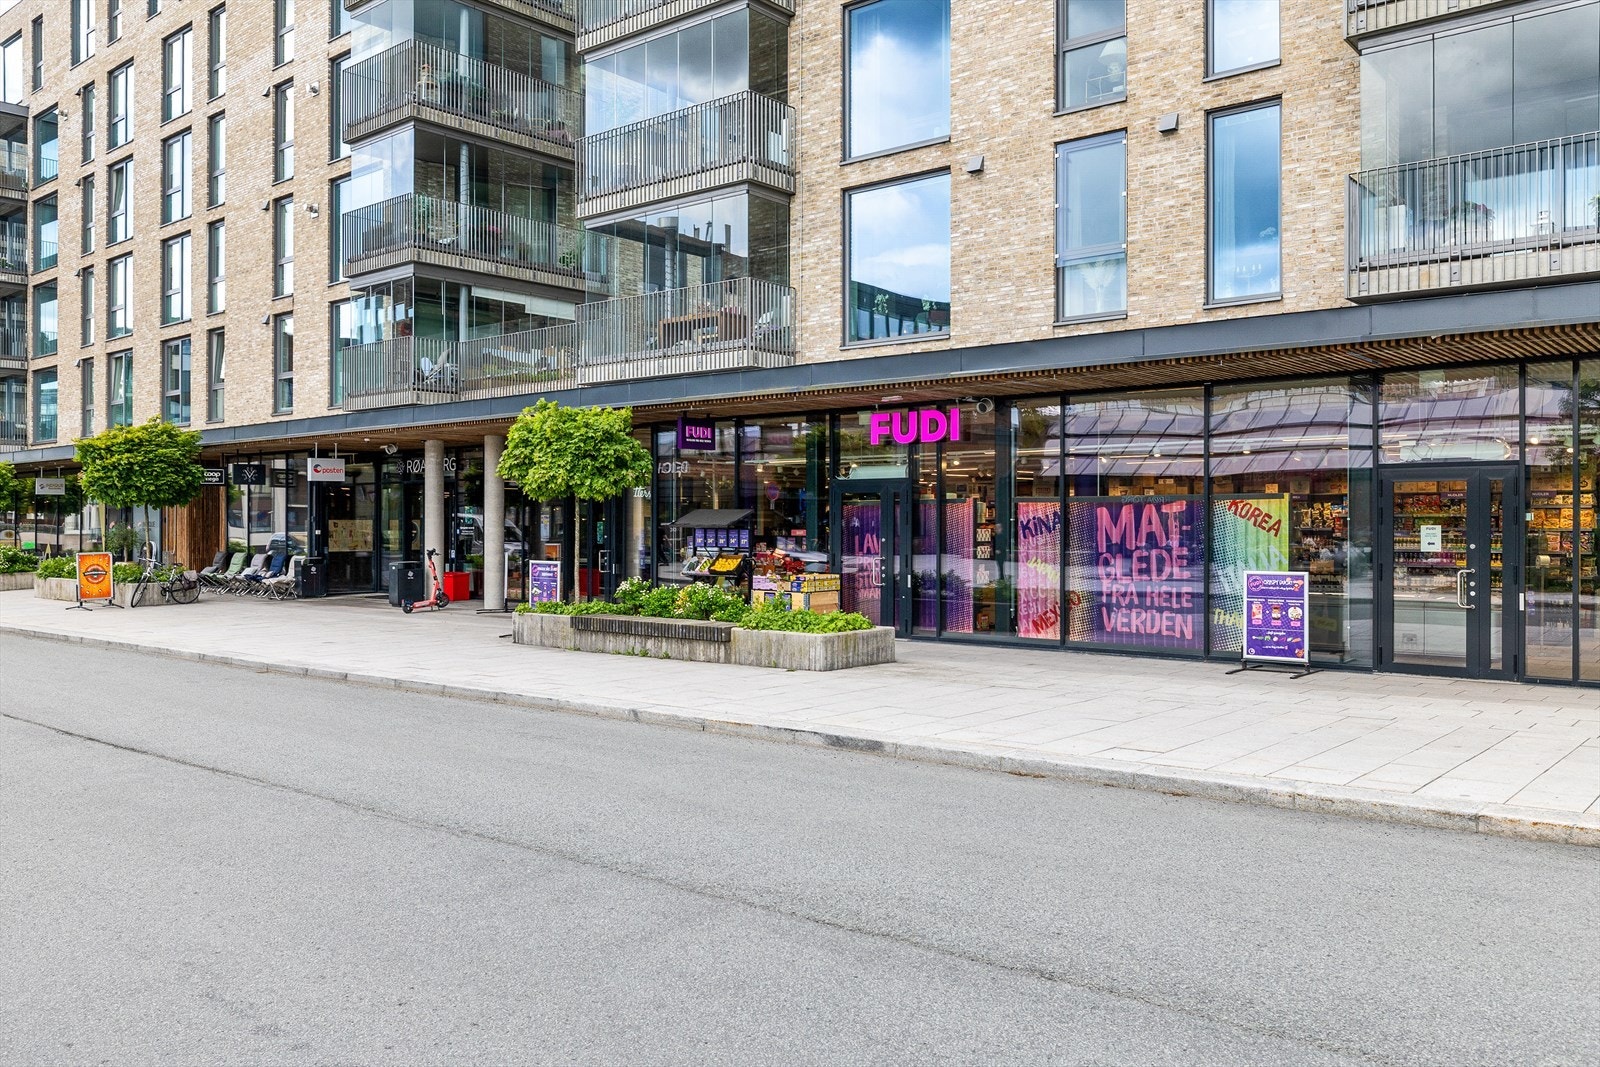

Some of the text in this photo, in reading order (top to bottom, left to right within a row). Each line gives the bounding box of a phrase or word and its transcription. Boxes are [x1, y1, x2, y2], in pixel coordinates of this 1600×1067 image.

[685, 425, 712, 439] FUDI
[870, 408, 960, 445] FUDI
[1227, 499, 1282, 538] KOREA
[1098, 546, 1192, 583] GLEDE
[1101, 581, 1193, 608] FRA HELE
[1101, 606, 1193, 640] VERDEN
